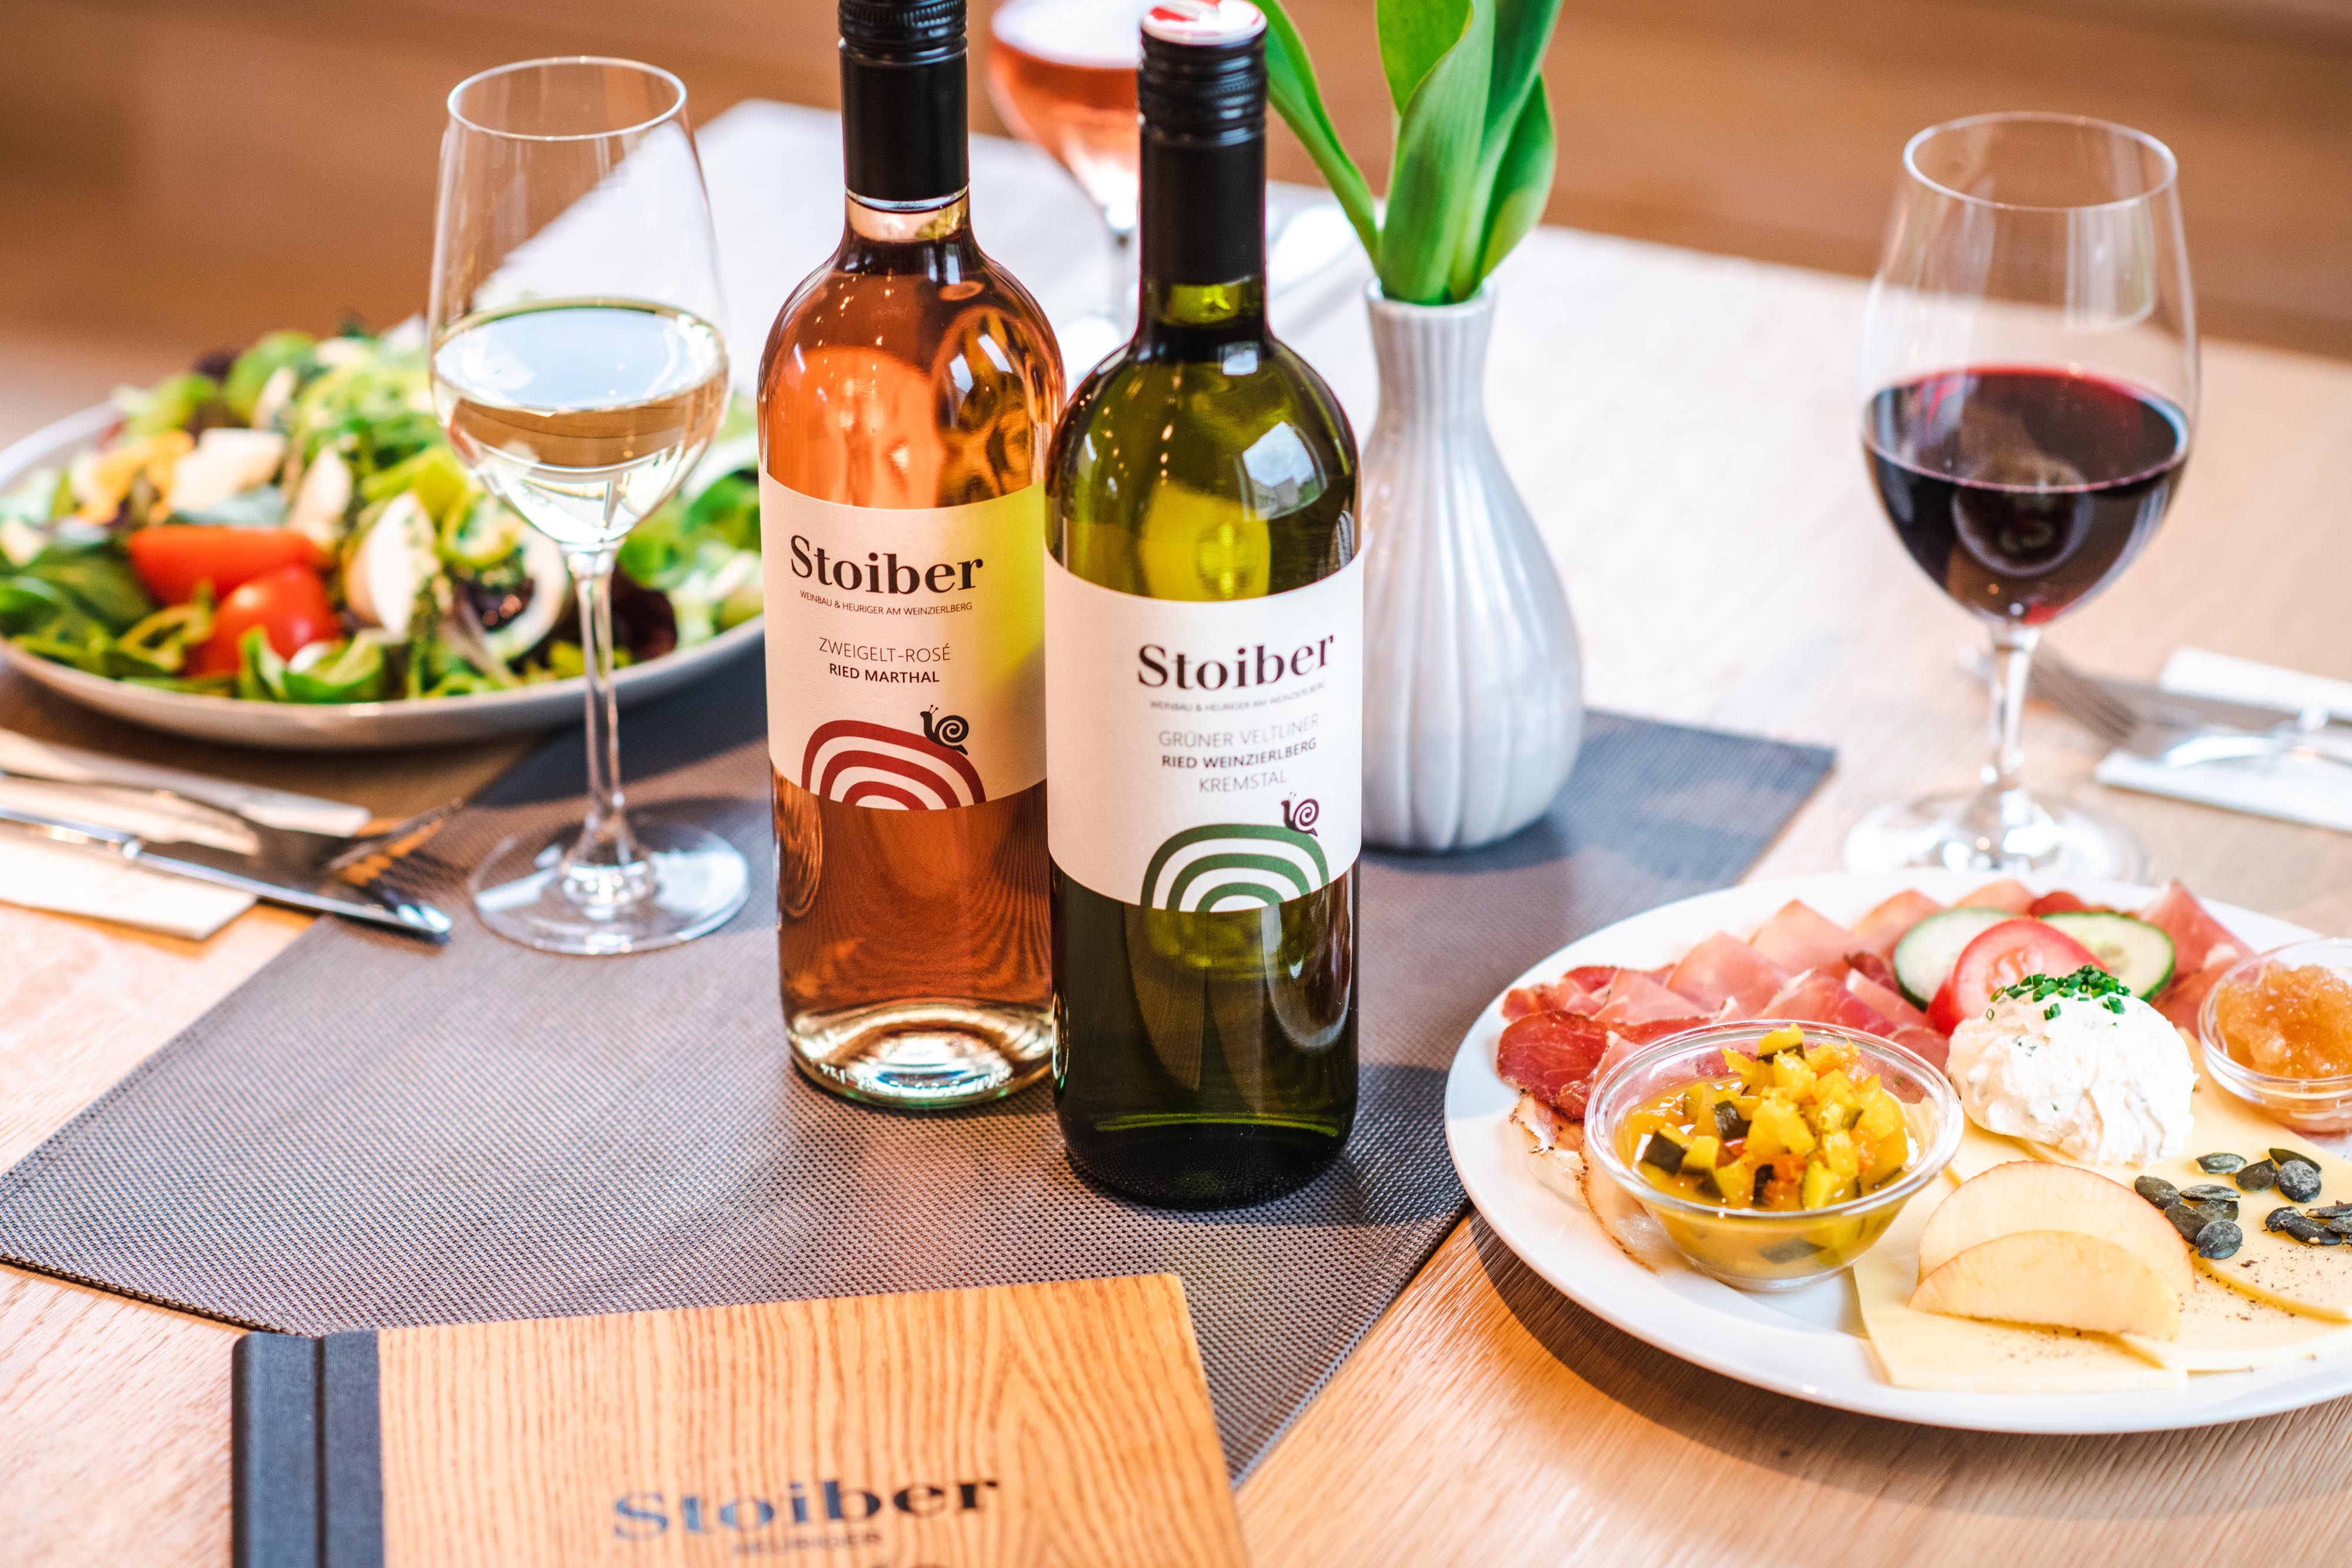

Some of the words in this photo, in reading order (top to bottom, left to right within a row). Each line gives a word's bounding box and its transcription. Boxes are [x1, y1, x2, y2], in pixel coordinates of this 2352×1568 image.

[790, 534, 984, 595] Stoiber
[800, 589, 832, 607] WEINBAU
[834, 600, 841, 609] &
[842, 601, 884, 615] HEURIGER
[886, 607, 901, 616] AM
[903, 601, 973, 616] WEINZIERLBERG
[818, 637, 951, 663] ZWEIGELT-ROSÉ
[1137, 633, 1335, 691] Stoiber
[829, 663, 860, 679] RIED
[864, 669, 940, 683] MARTHAL
[1158, 729, 1234, 749] GRÜNER
[1240, 713, 1319, 745] VELTLINER
[1161, 754, 1198, 769] RIED
[1202, 737, 1317, 769] WEINZIERLBERG
[1198, 769, 1287, 794] KREMSTAL
[613, 1476, 1000, 1542] Stoiber
